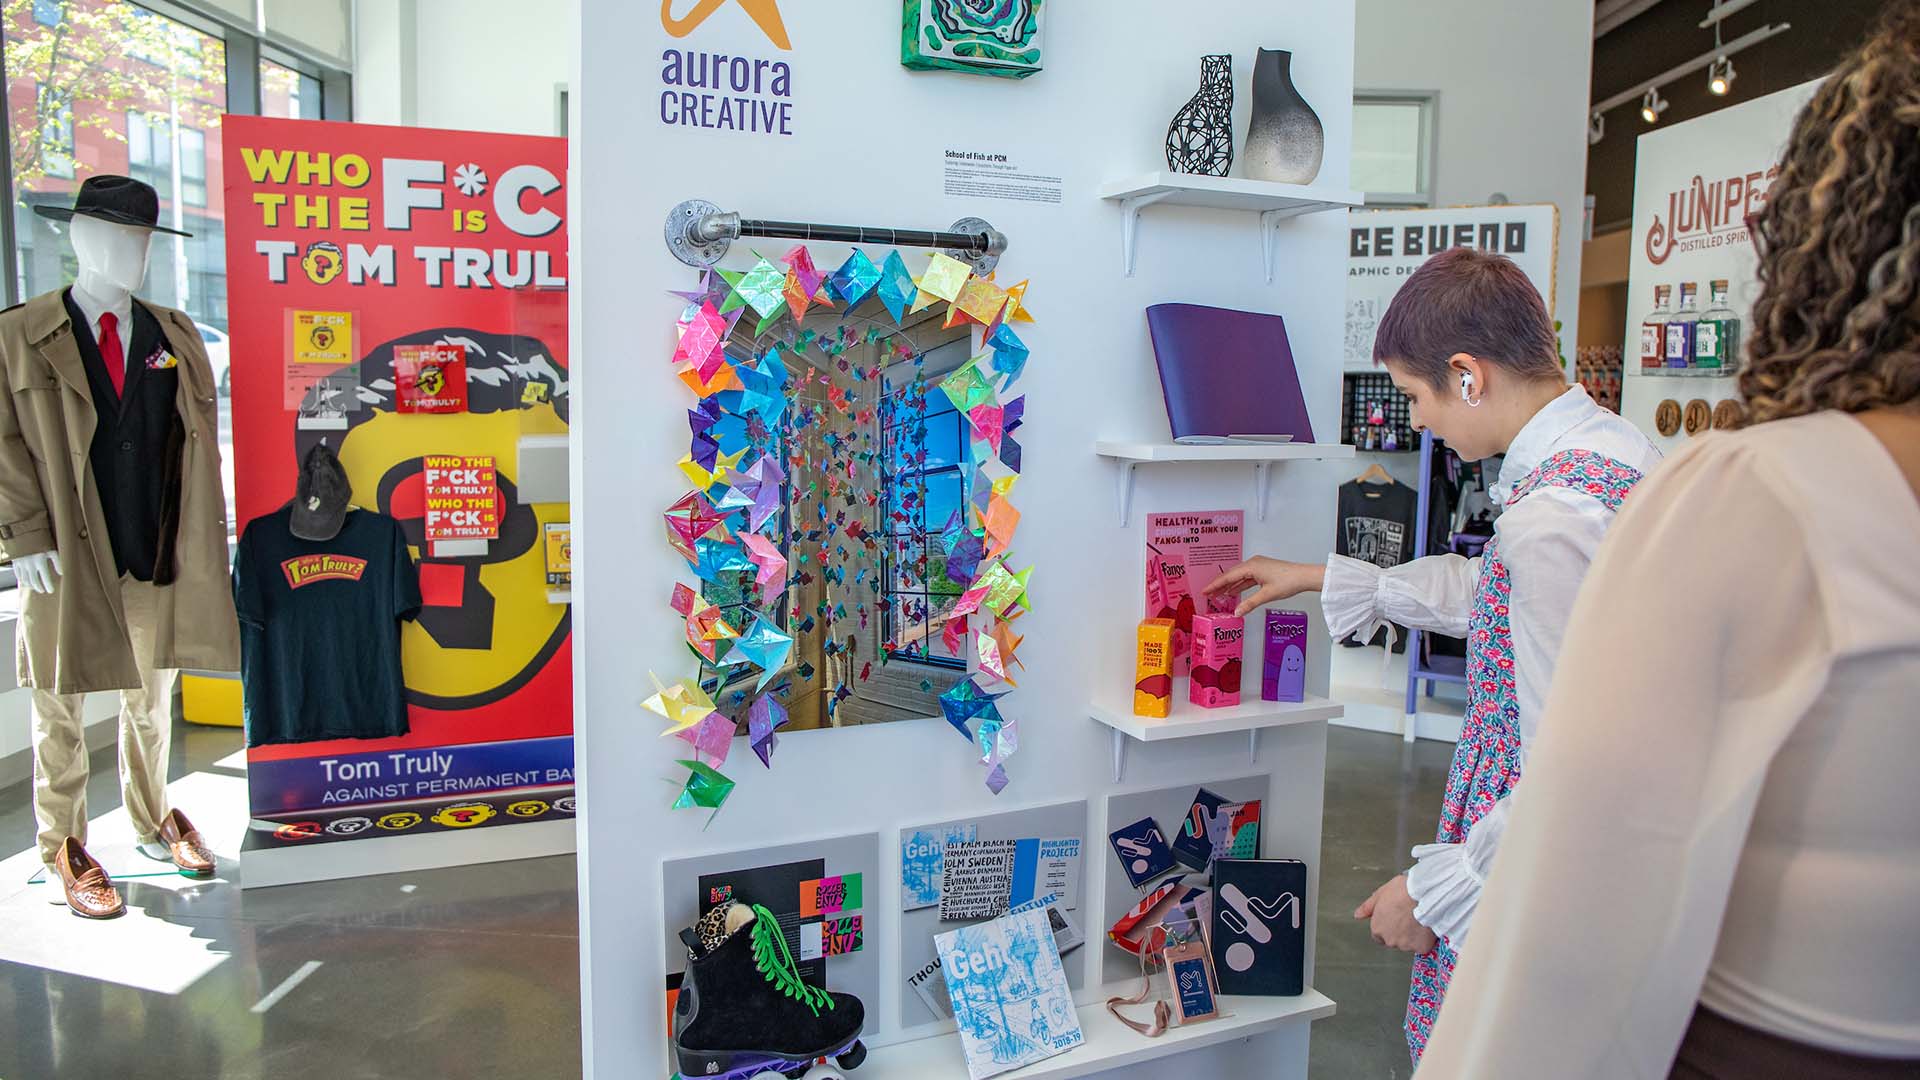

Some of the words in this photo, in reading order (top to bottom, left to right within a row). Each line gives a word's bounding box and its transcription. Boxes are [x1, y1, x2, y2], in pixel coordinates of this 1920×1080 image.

[661, 49, 791, 97] aurora
[660, 90, 793, 136] CREATIVE
[945, 150, 965, 159] School
[965, 152, 973, 160] of
[973, 153, 985, 161] Fish
[993, 154, 1007, 163] PCM
[240, 147, 370, 188] WHO
[382, 158, 568, 238] FC
[253, 192, 370, 231] THE
[453, 208, 488, 233] IS
[1403, 222, 1526, 256] BUENO
[1680, 235, 1723, 252] DISTILLED
[1725, 231, 1752, 246] SPIRI
[414, 245, 568, 291] TRUL
[426, 457, 462, 467] WHO
[465, 457, 493, 467] THE
[482, 472, 493, 481] IS
[453, 486, 494, 494] TRULY?
[427, 499, 463, 509] WHO
[466, 498, 494, 508] THE
[484, 514, 495, 522] IS
[1155, 516, 1200, 527] HEALTHY
[454, 527, 496, 536] TRULY?
[1155, 537, 1182, 545] FANGS
[1160, 561, 1186, 579] Fangs
[1214, 626, 1242, 643] Fangs
[1268, 621, 1305, 639] Fangs
[320, 759, 380, 782] Tom
[389, 751, 453, 777] Truly
[321, 783, 409, 804] AGAINST
[416, 770, 541, 796] PERMANENT
[1006, 839, 1017, 847] US
[1041, 839, 1080, 849] HIGHLIGHTED
[1040, 847, 1079, 860] PROJECTS
[968, 855, 1004, 868] SWEDEN
[951, 876, 978, 886] VIENNA
[980, 874, 1008, 884] AUSTRIA
[948, 911, 968, 919] BERN
[1053, 1032, 1081, 1049] 2018-19
